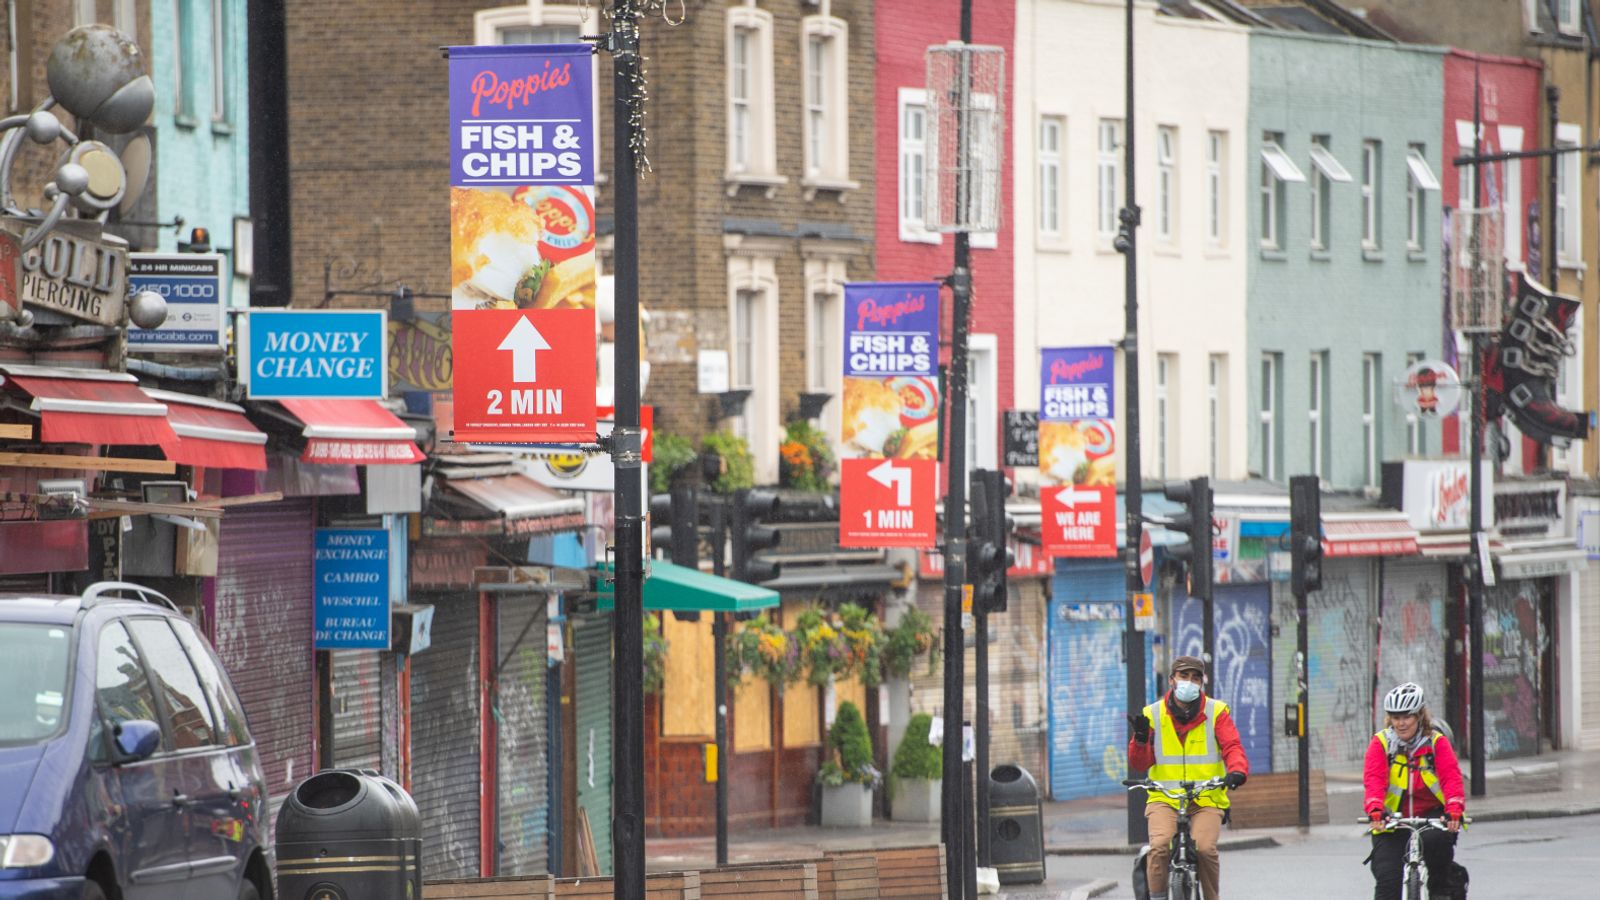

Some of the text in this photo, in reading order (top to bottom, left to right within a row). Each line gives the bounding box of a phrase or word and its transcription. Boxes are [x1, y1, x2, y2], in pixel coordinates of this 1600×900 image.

[471, 60, 571, 117] Poppies
[461, 124, 582, 149] FISH &
[462, 152, 582, 177] CHIPS
[170, 264, 214, 272] MINICABS
[22, 273, 103, 317] PIERCING
[173, 284, 214, 297] 1000
[857, 292, 925, 332] Poppies
[264, 332, 369, 353] MONEY
[850, 335, 930, 354] FISH &
[256, 357, 374, 378] CHANGE
[850, 353, 931, 371] CHIPS
[487, 389, 563, 415] 2 MIN
[1044, 386, 1108, 403] FISH &
[1044, 401, 1109, 417] CHIPS
[863, 509, 914, 529] 1 MIN
[1055, 511, 1102, 526] WE ARE
[327, 535, 375, 546] MONEY
[1063, 526, 1095, 541] HERE
[316, 549, 388, 560] EXCHANGE
[324, 572, 380, 583] CAMBIO
[322, 596, 381, 606] WESCHEL
[325, 617, 376, 628] BUREAU
[316, 630, 386, 641] DE CHANGE
